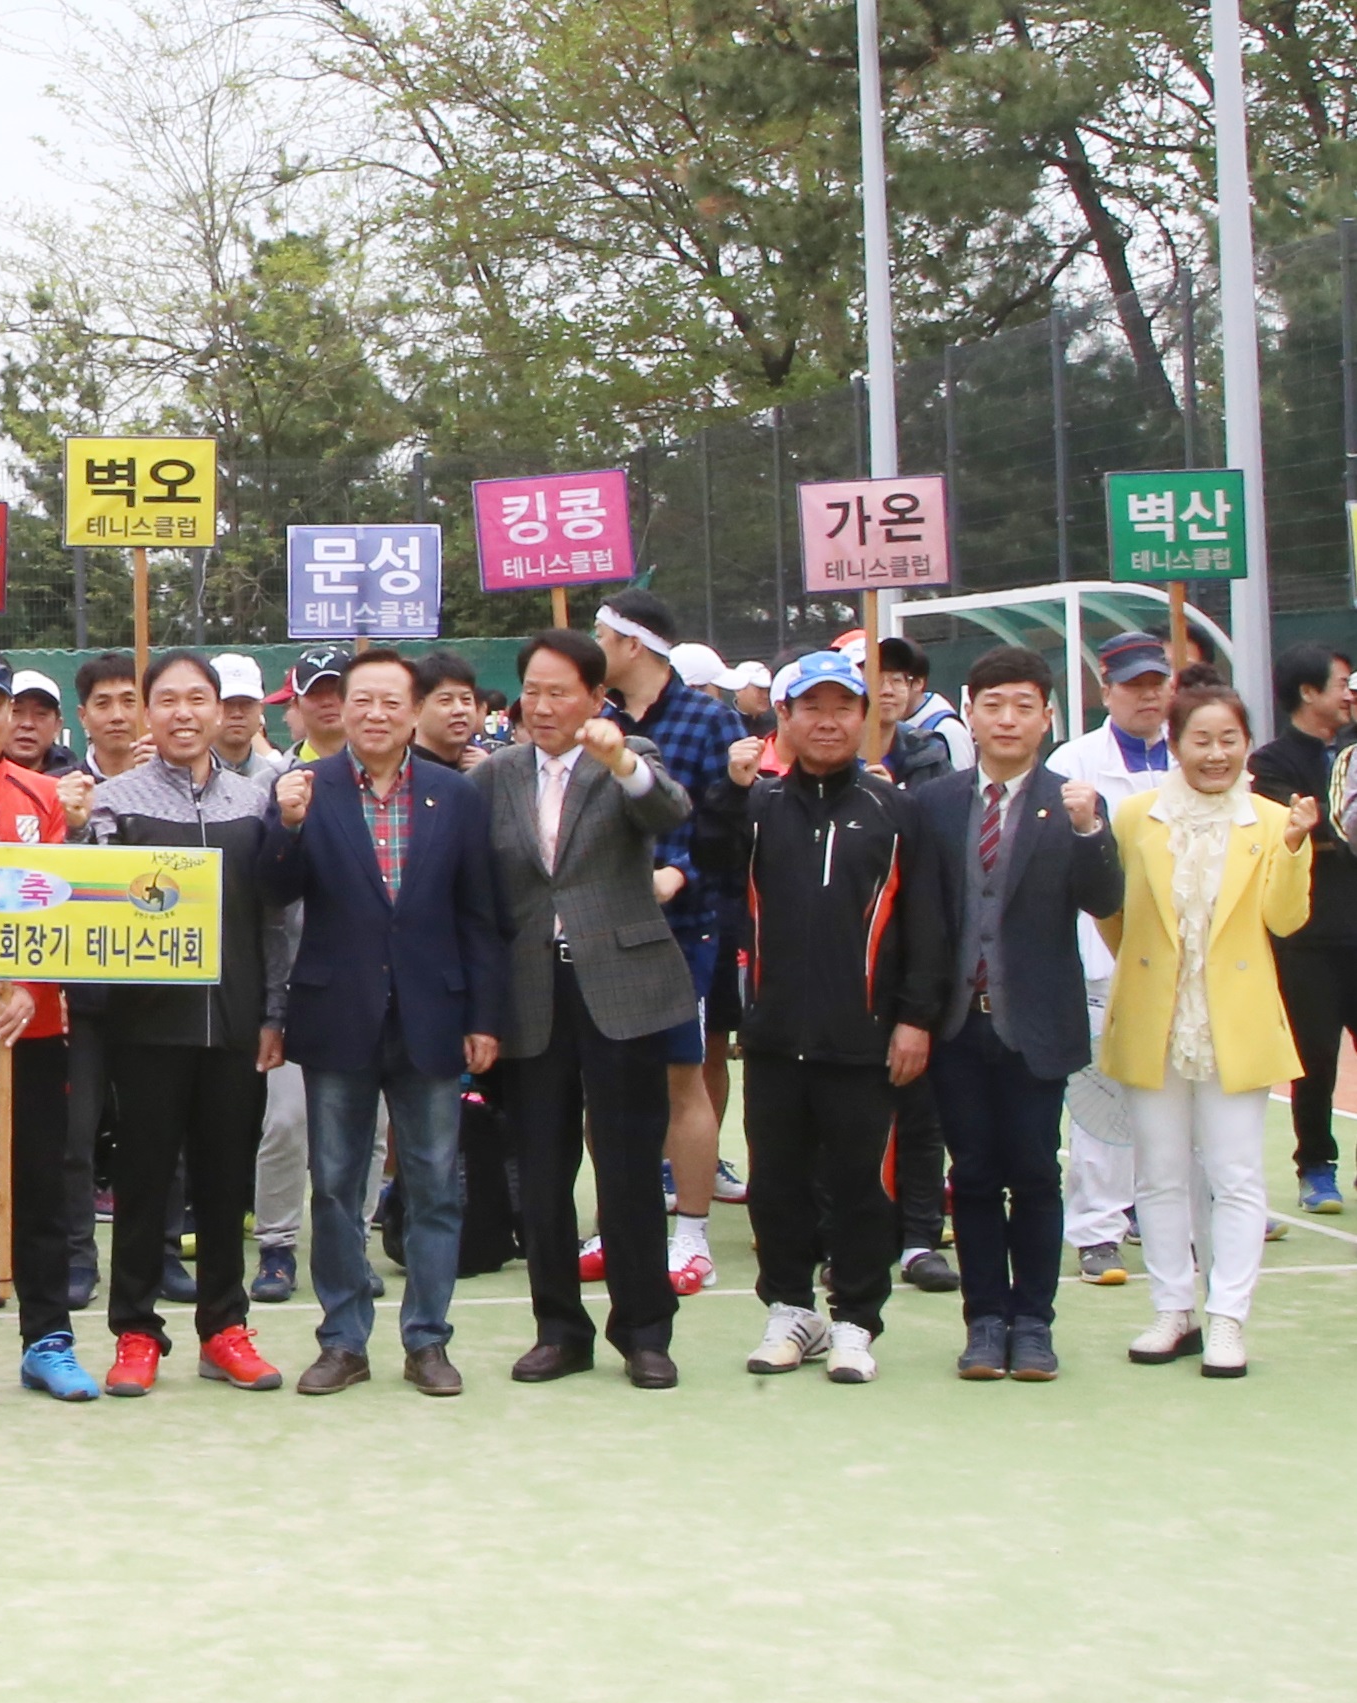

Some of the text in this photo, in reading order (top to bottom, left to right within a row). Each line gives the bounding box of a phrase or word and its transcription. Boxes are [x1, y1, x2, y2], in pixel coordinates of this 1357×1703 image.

[86, 457, 201, 508] 벽오
[86, 516, 197, 538] 테니스클럽
[501, 487, 608, 545] 킹콩
[825, 493, 925, 546] 가온
[1127, 489, 1232, 543] 벽산
[304, 536, 421, 595] 문성
[502, 548, 614, 579] 테니스클럽
[825, 554, 930, 581] 테니스클럽
[1130, 548, 1231, 572] 테니스클럽
[304, 601, 425, 627] 테니스클럽
[87, 925, 202, 968] 테니스대회
